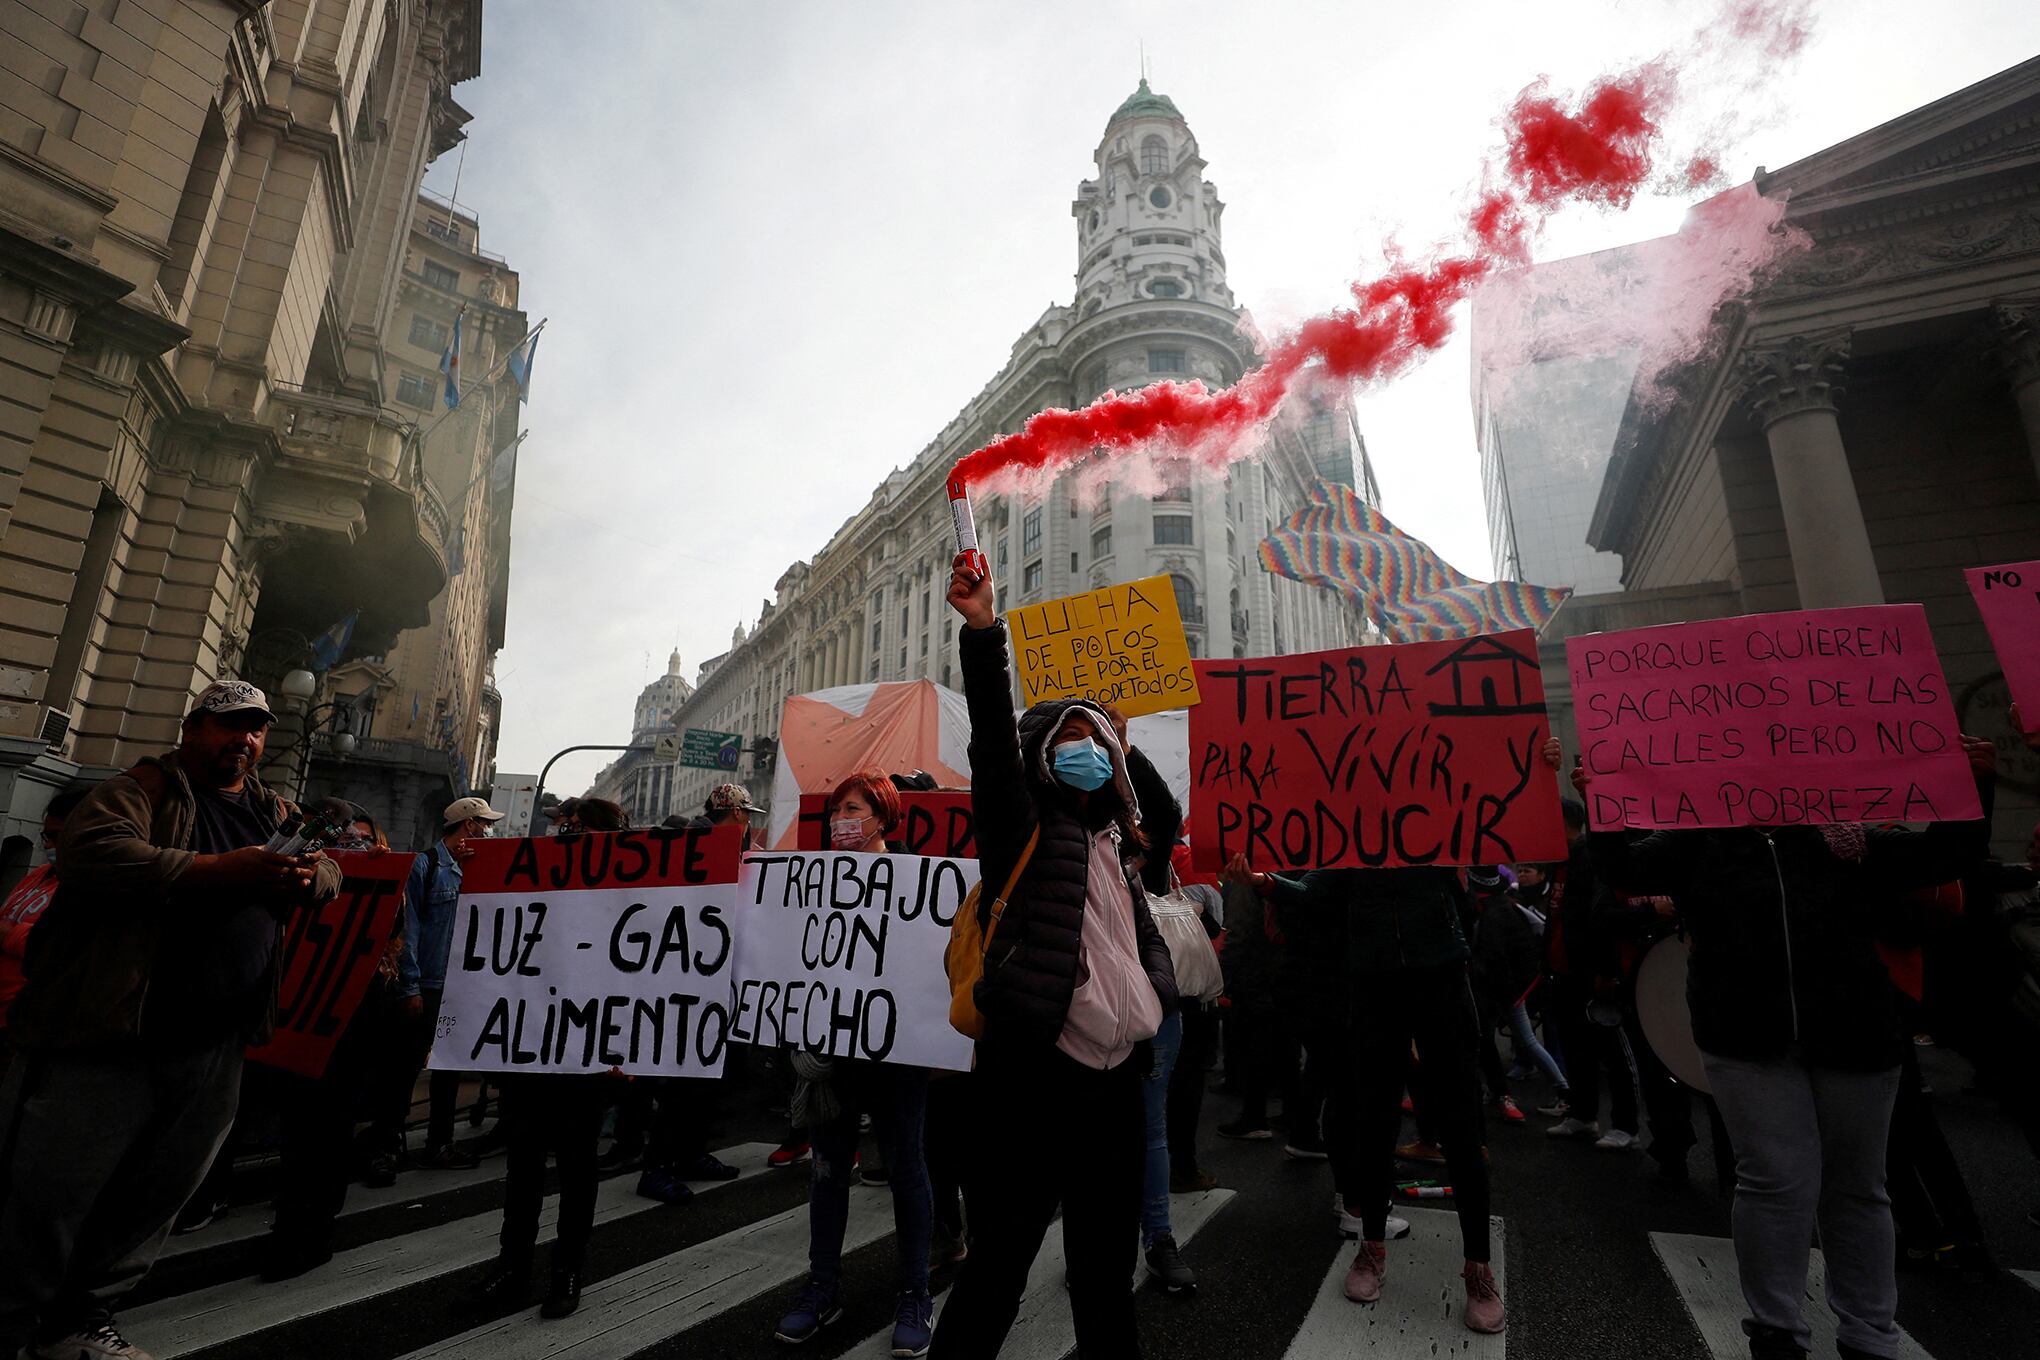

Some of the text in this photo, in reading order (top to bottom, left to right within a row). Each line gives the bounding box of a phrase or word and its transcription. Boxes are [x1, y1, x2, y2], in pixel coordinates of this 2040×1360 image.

[1984, 571, 2021, 589] NO
[1020, 586, 1160, 640] LUCHA
[1026, 624, 1159, 671] DE POCOS
[1027, 651, 1165, 697] VALE POR EL
[1587, 673, 1939, 731] SACARNOS DE LAS
[1199, 741, 1281, 800] PARA
[1587, 720, 1947, 776] CALLES PERO NO
[1717, 781, 1942, 825] POBREZA
[743, 855, 967, 927] TRABAJO
[462, 902, 548, 976] LUZ
[609, 903, 731, 976] GAS
[801, 911, 890, 978] CON
